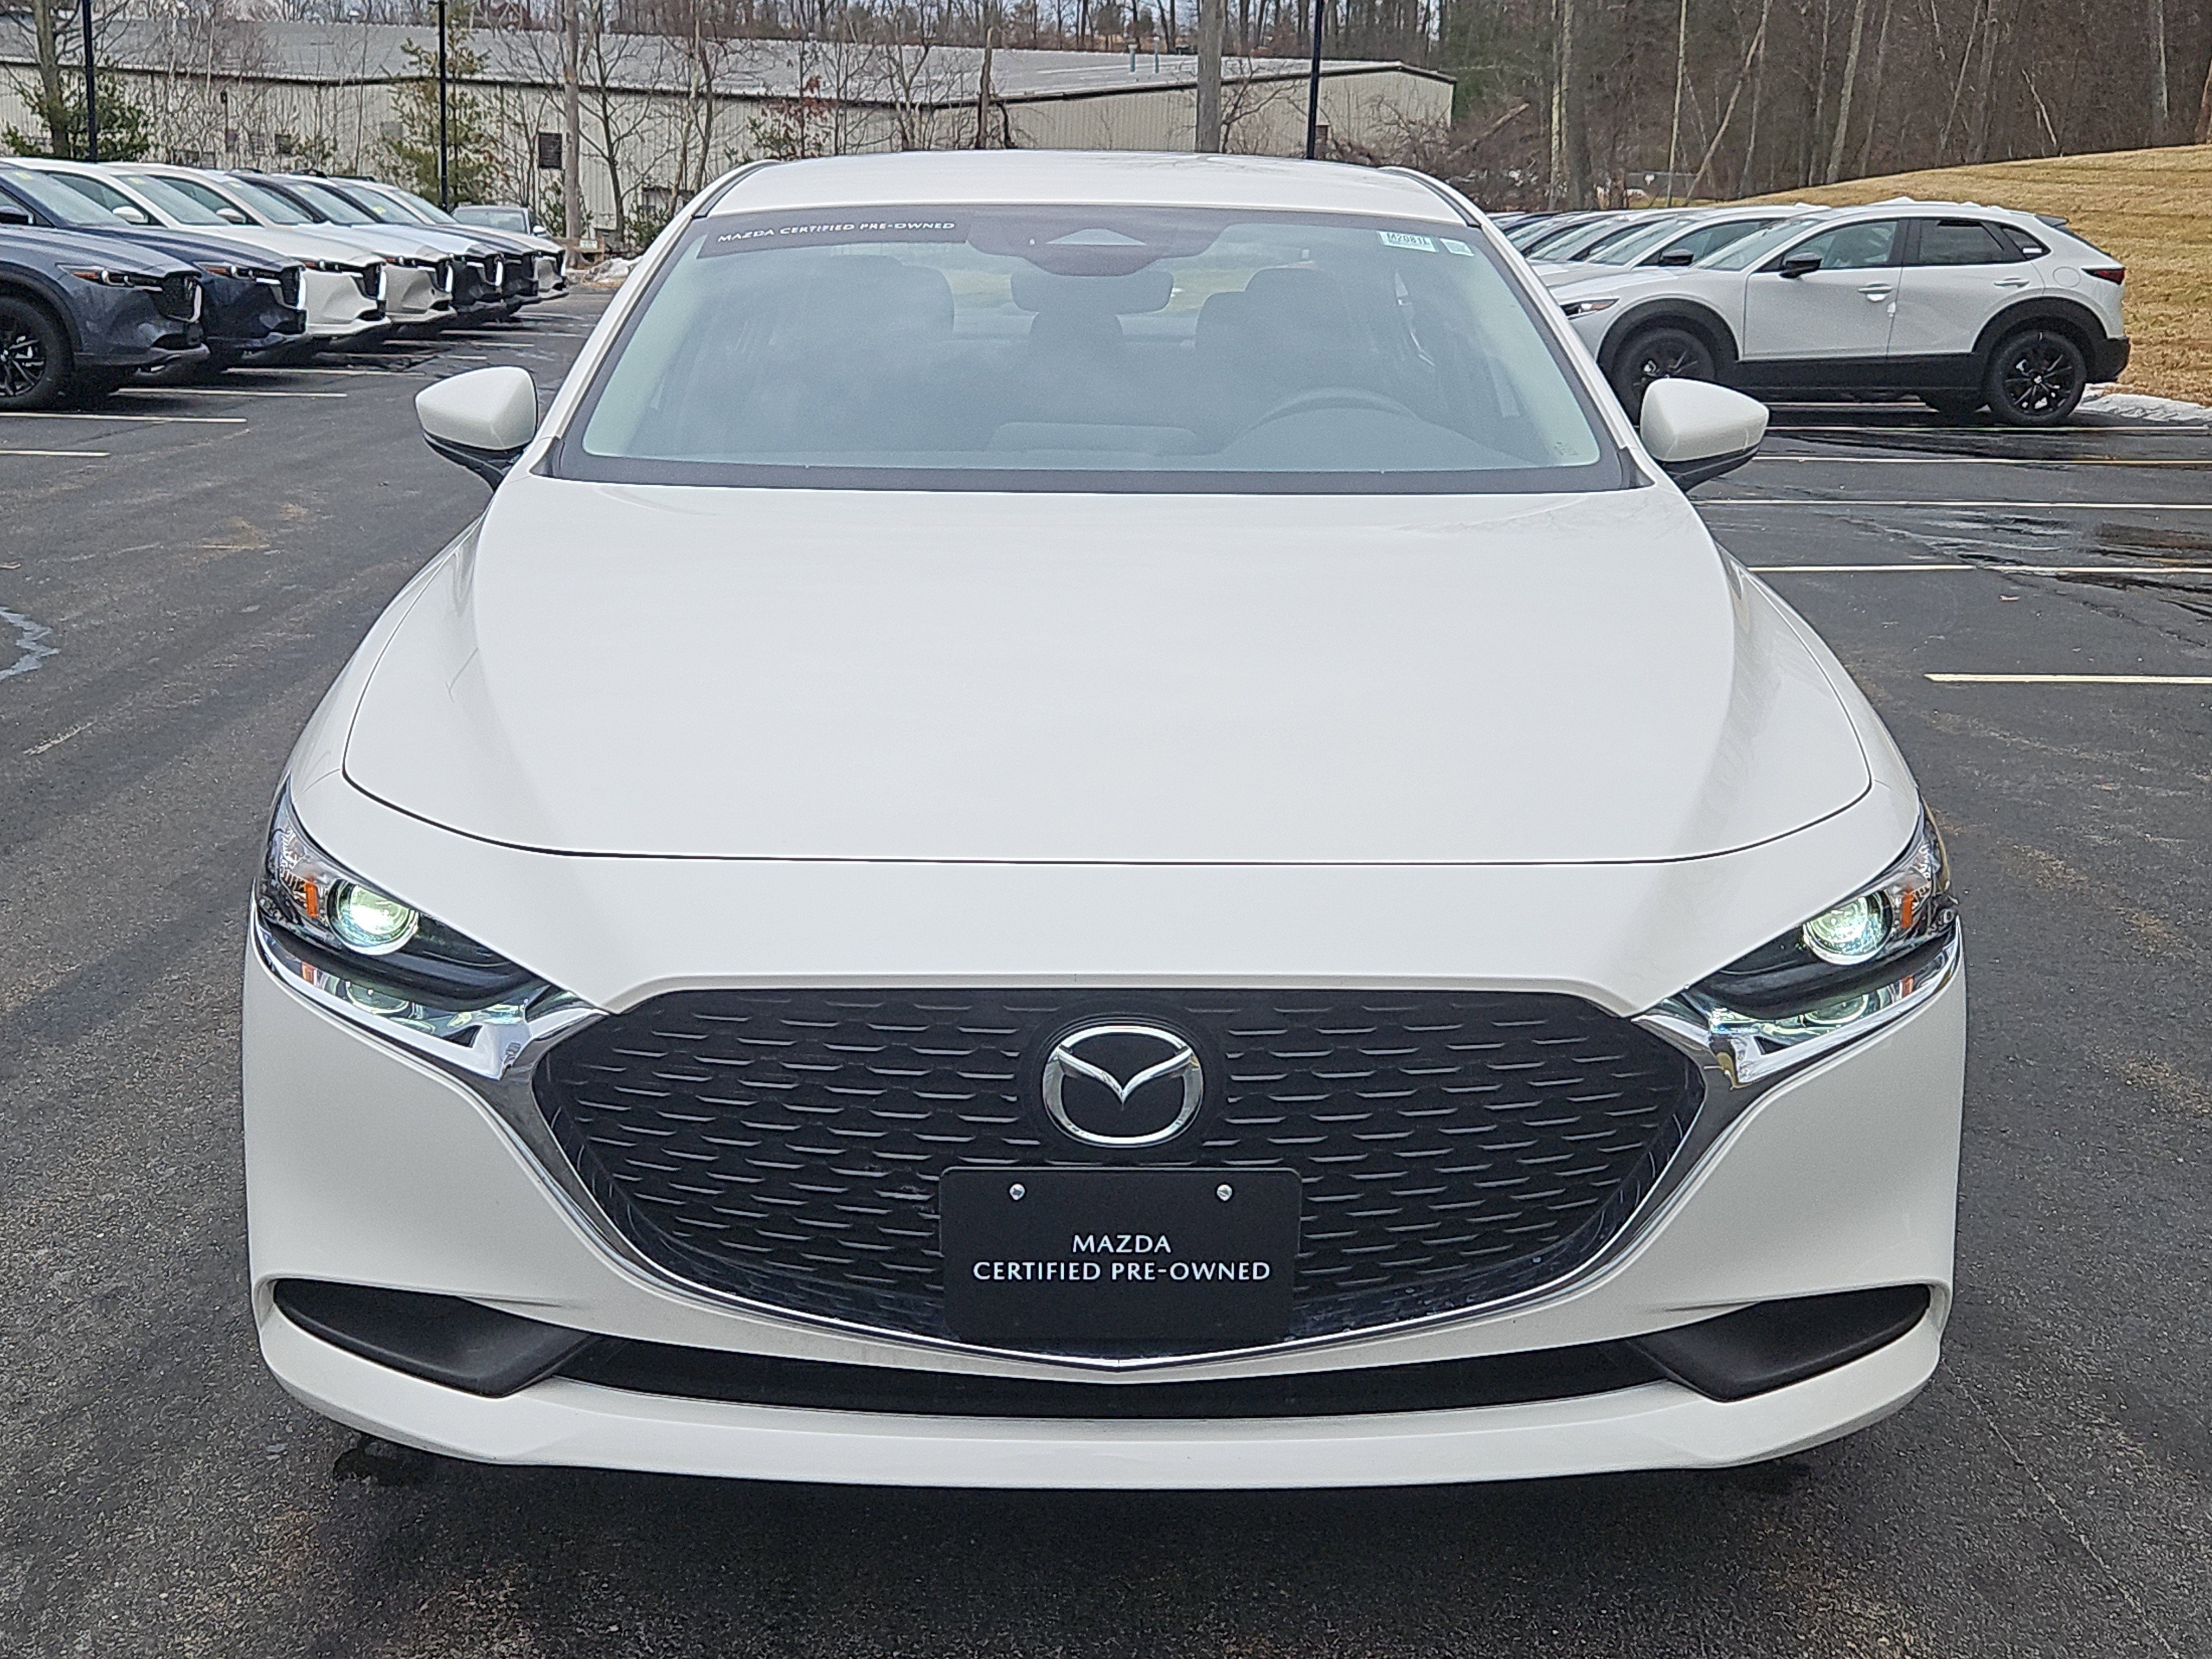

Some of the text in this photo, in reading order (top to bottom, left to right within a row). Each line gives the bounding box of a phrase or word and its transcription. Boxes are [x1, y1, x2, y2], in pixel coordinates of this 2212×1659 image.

[717, 222, 956, 243] MAZDA CERTIFIED PRE-OWNED
[1072, 1234, 1172, 1253] MAZDA
[973, 1262, 1270, 1281] CERTIFIED PRE-OWNED
